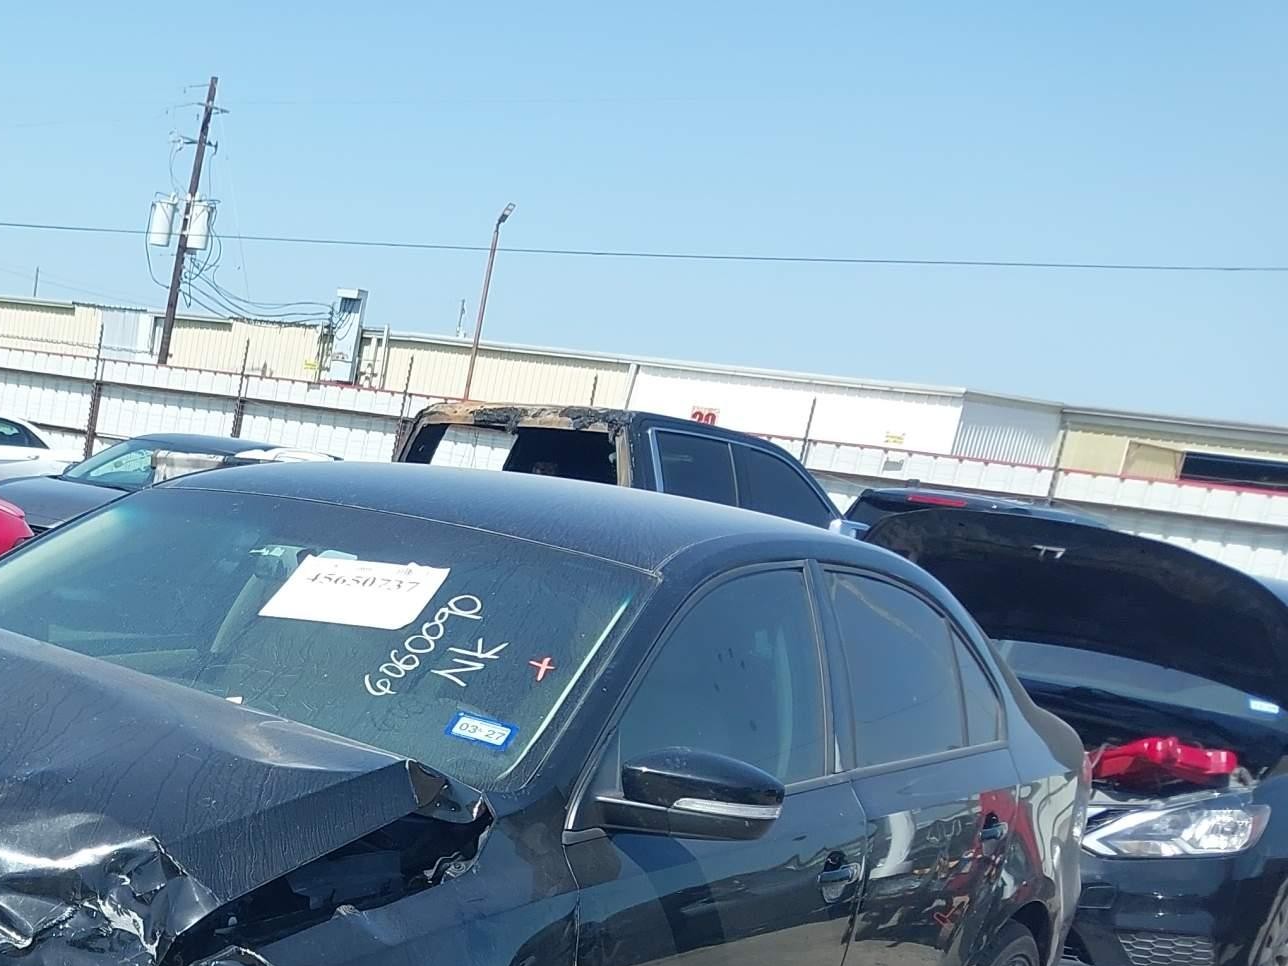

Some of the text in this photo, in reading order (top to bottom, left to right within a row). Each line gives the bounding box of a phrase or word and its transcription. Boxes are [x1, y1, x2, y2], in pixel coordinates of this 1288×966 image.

[305, 572, 421, 592] 45650737
[458, 722, 506, 741] 03 27
